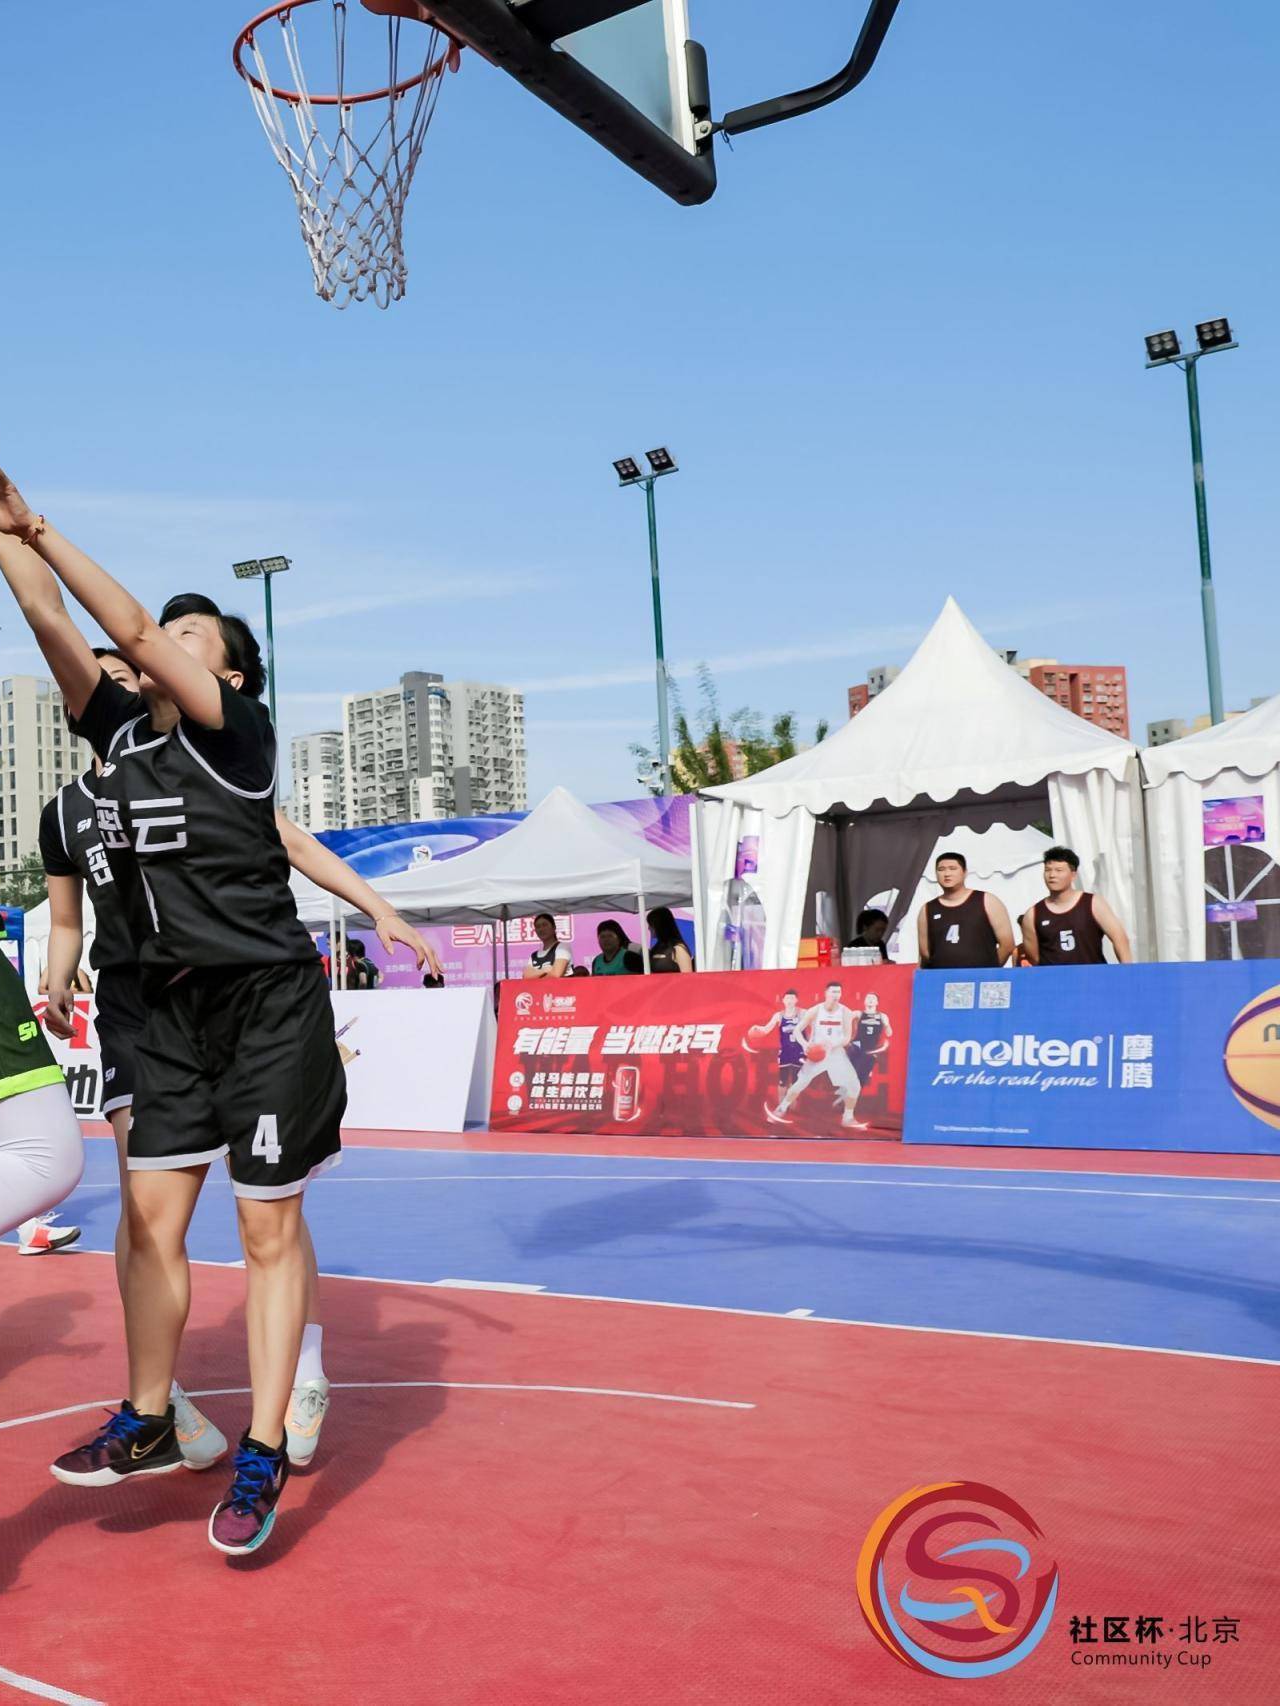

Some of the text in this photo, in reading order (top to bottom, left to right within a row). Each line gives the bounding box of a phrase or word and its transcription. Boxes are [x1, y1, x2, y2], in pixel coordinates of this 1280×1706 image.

[945, 923, 960, 944] 4
[1060, 930, 1076, 951] 5
[513, 1023, 725, 1055] 有能量 当燃战马
[939, 1035, 1099, 1067] molten
[1120, 1034, 1154, 1089] 摩腾
[931, 1070, 1099, 1093] For the real game
[251, 1114, 282, 1164] 4
